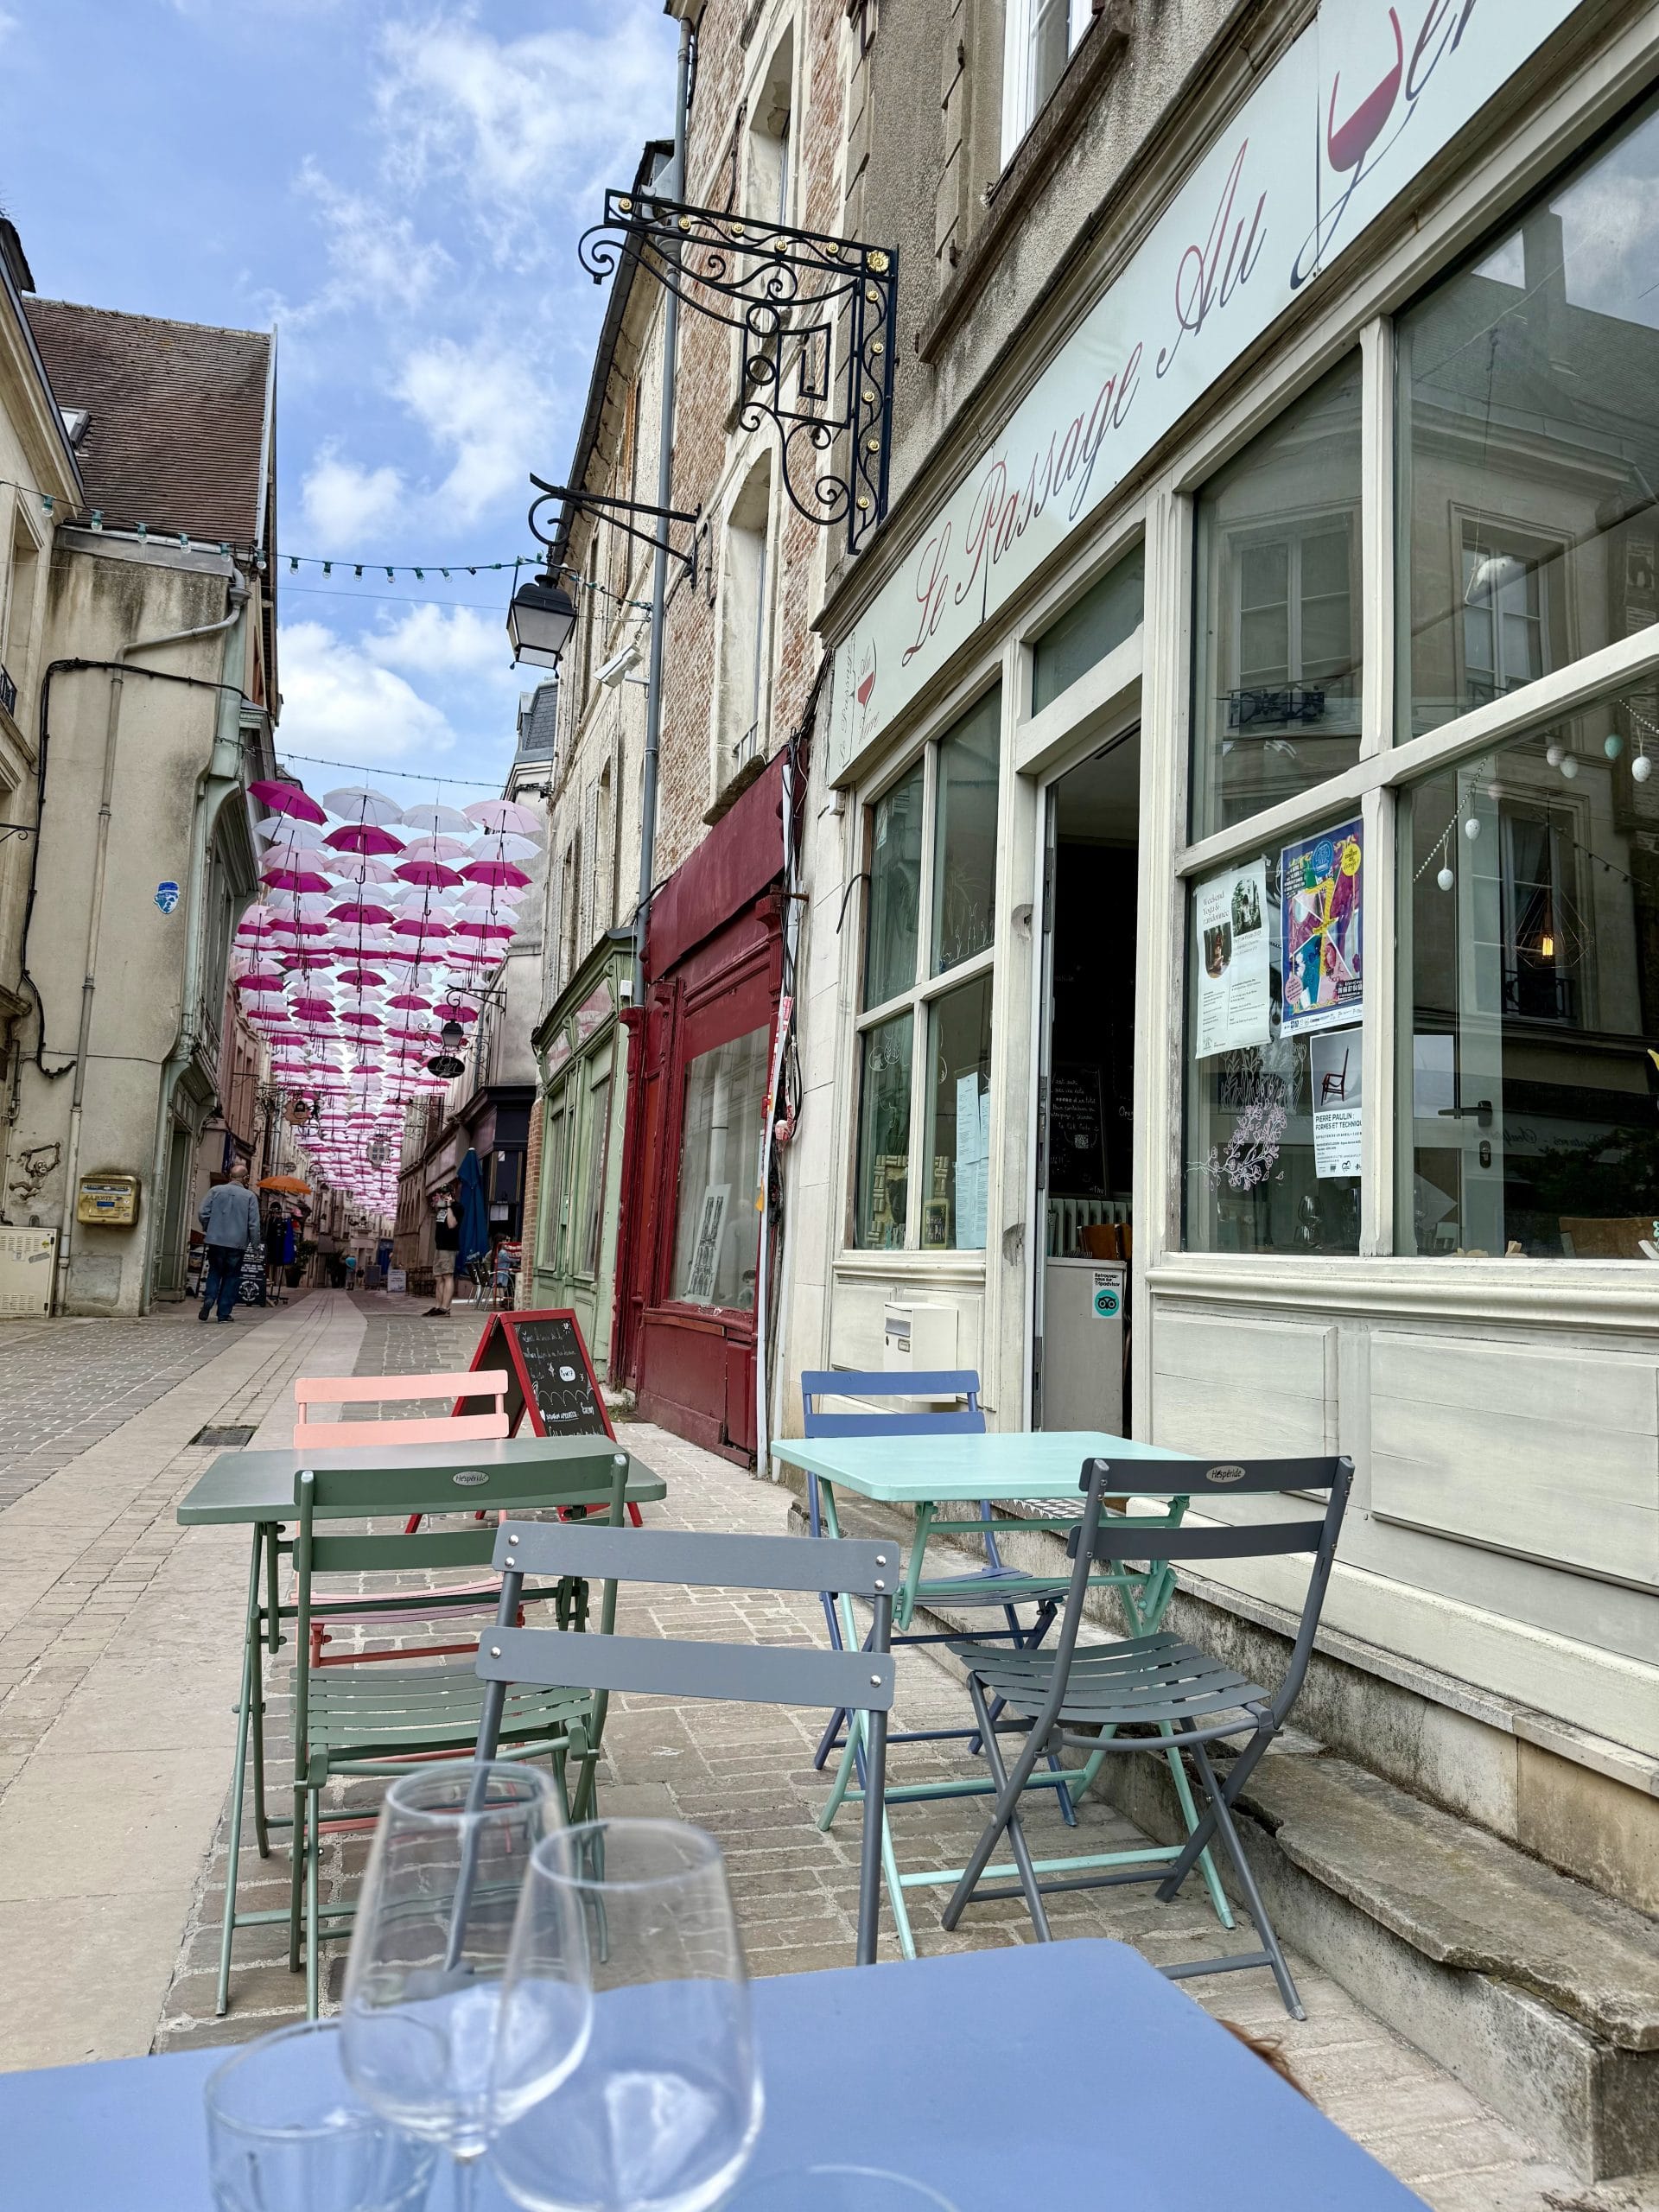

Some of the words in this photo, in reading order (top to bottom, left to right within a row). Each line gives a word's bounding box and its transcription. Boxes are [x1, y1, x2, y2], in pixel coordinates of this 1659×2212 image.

[901, 520, 952, 668] Le
[954, 340, 1143, 606] Passage
[1156, 137, 1268, 378] Au
